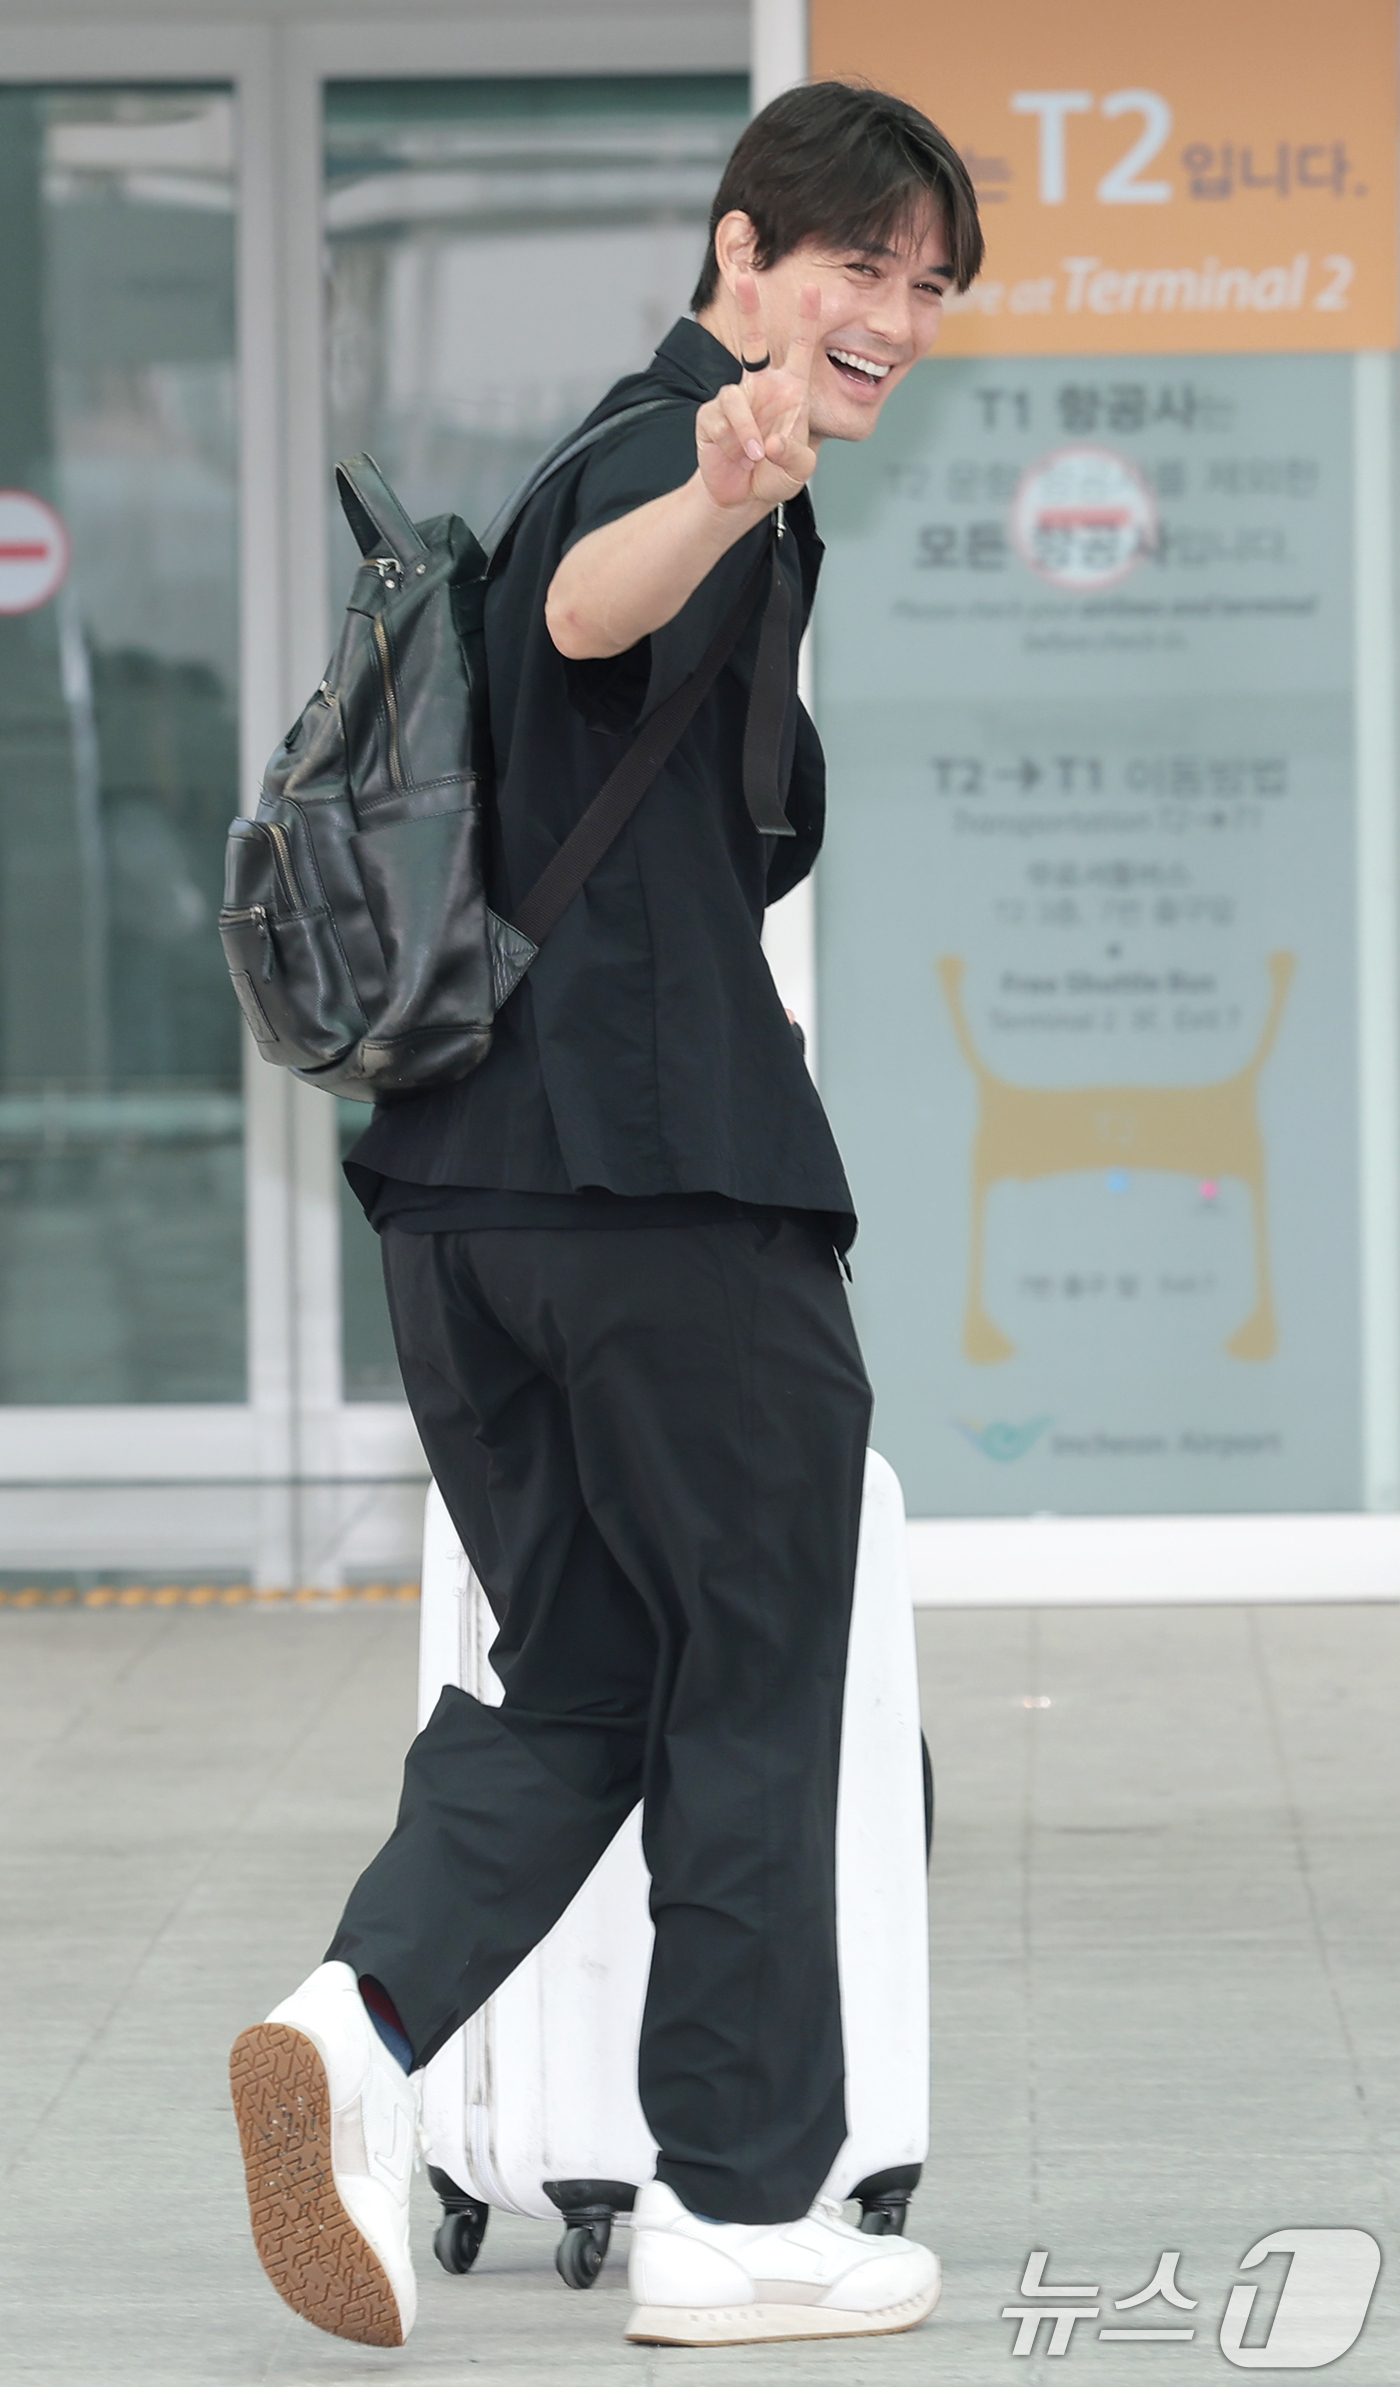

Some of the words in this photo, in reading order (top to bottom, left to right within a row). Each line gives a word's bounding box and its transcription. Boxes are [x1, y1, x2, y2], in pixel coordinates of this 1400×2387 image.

[1009, 277, 1056, 315] at
[1060, 253, 1309, 314] Terminal
[1313, 254, 1355, 312] 2
[974, 388, 1032, 431] T1
[914, 522, 1008, 572] 모든
[1051, 1430, 1167, 1456] Incheon
[1177, 1430, 1282, 1460] Airport
